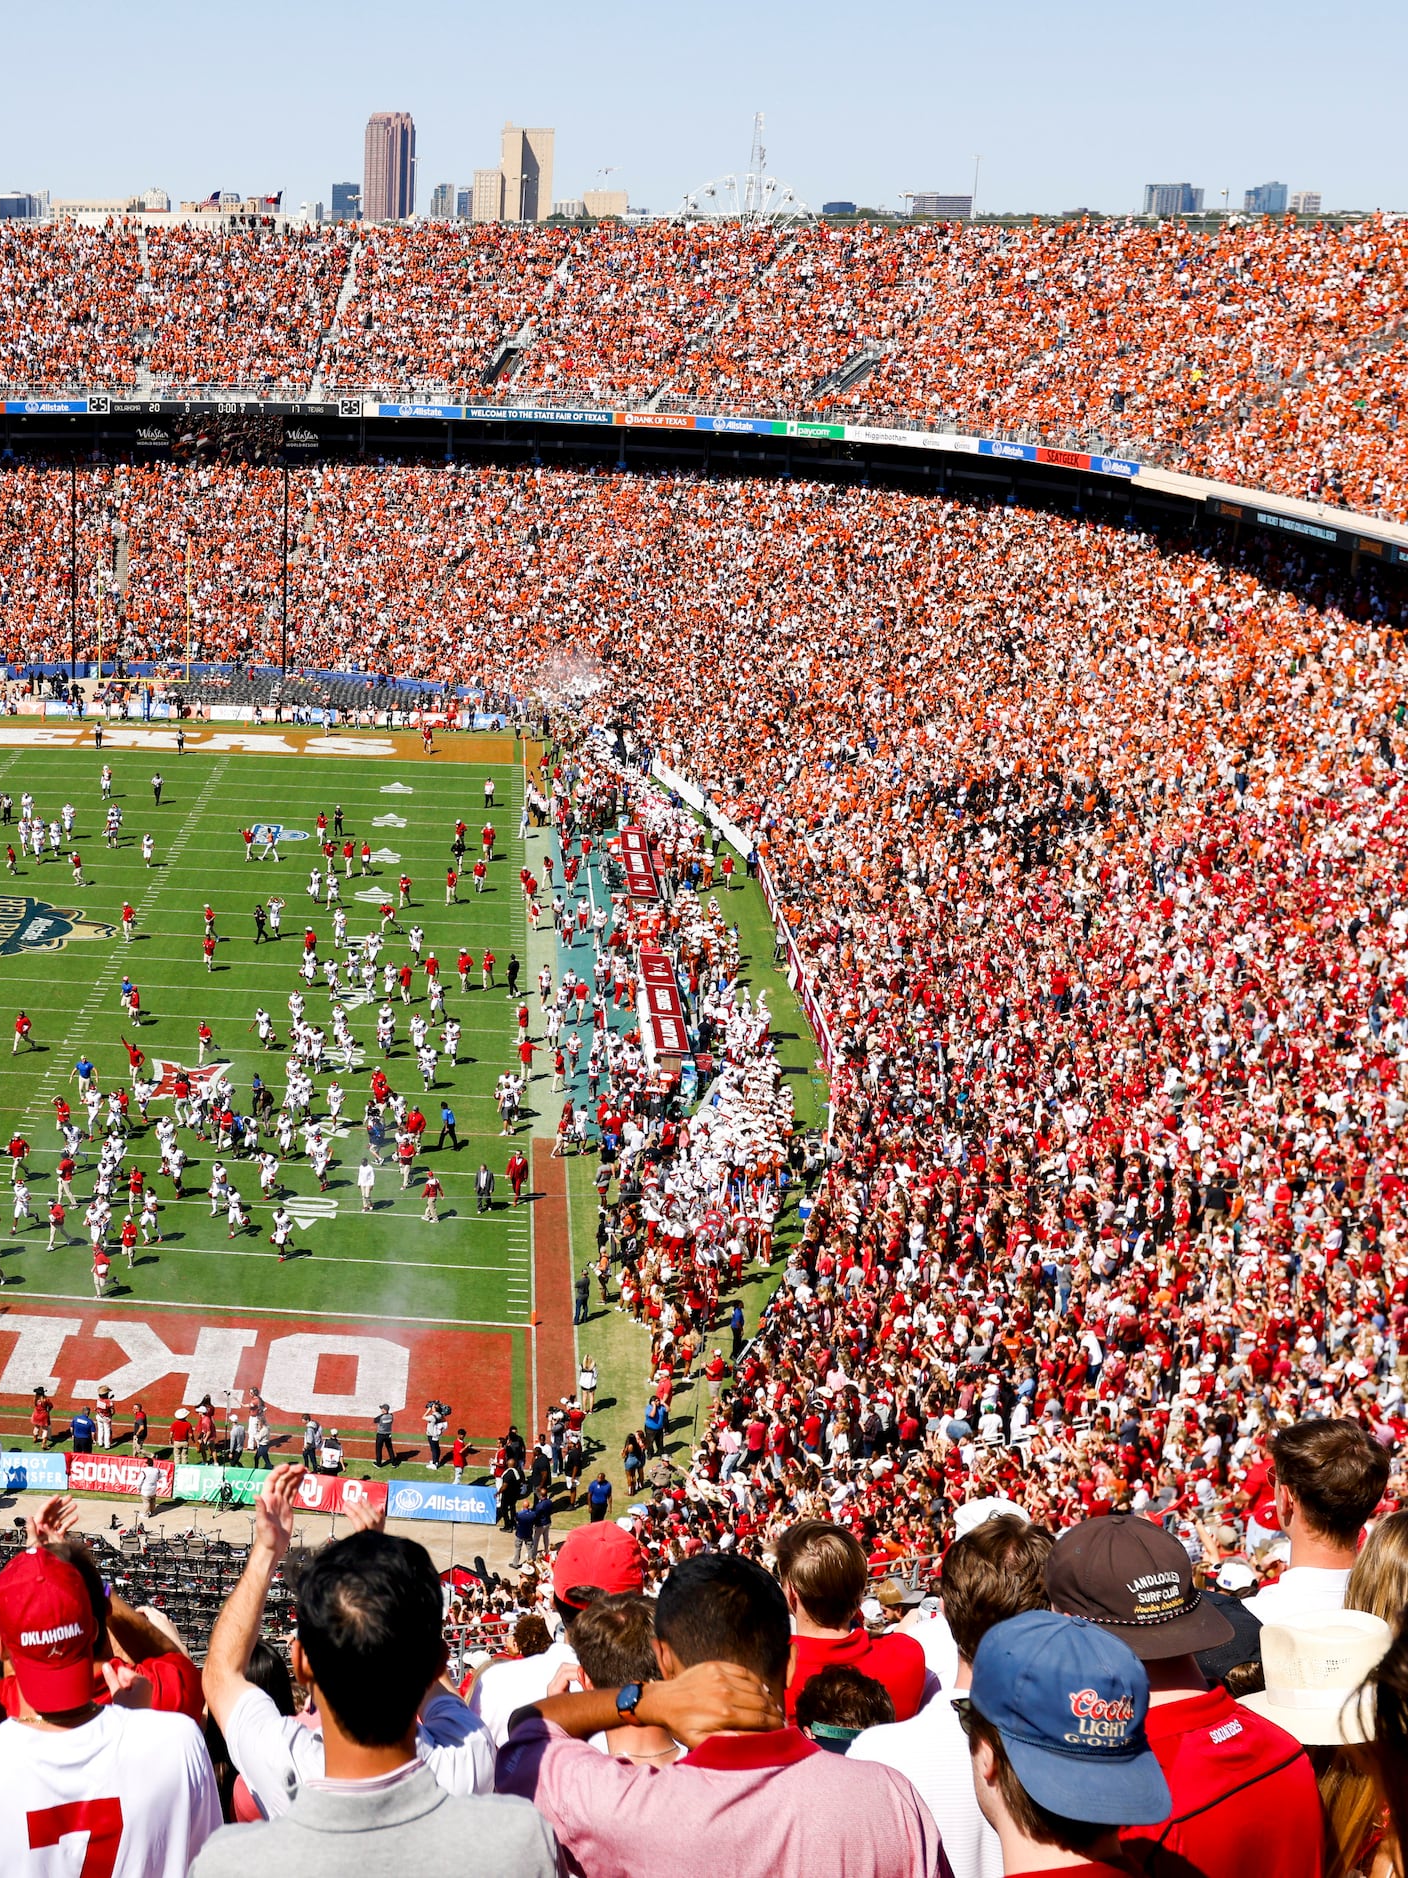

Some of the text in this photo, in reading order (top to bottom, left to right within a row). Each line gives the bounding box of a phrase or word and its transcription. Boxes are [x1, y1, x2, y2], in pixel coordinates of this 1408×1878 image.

[39, 403, 70, 412] Allstate
[90, 399, 106, 411] 25
[149, 403, 160, 413] 20
[218, 403, 237, 413] 0:00
[290, 405, 300, 413] 17
[342, 401, 359, 413] 25
[412, 407, 443, 417] Allstate
[471, 409, 507, 418] WELCOME
[518, 411, 532, 419] THE
[634, 416, 654, 424] BANK
[665, 417, 687, 425] TEXAS
[725, 421, 754, 431] Allstate
[797, 427, 831, 437] paycom
[865, 431, 907, 442] Higginbotham
[1047, 450, 1080, 467] SEATGEEK
[20, 916, 55, 941] Allstate
[1, 1458, 49, 1470] NERGY
[71, 1460, 169, 1488] SOONES
[299, 1473, 323, 1507] OU
[1126, 1570, 1181, 1594] LANDLOCKED
[1137, 1584, 1180, 1604] SURF CLUB
[1068, 1688, 1135, 1722] Coors
[1078, 1719, 1129, 1738] LIGHT
[26, 1796, 124, 1878] 7
